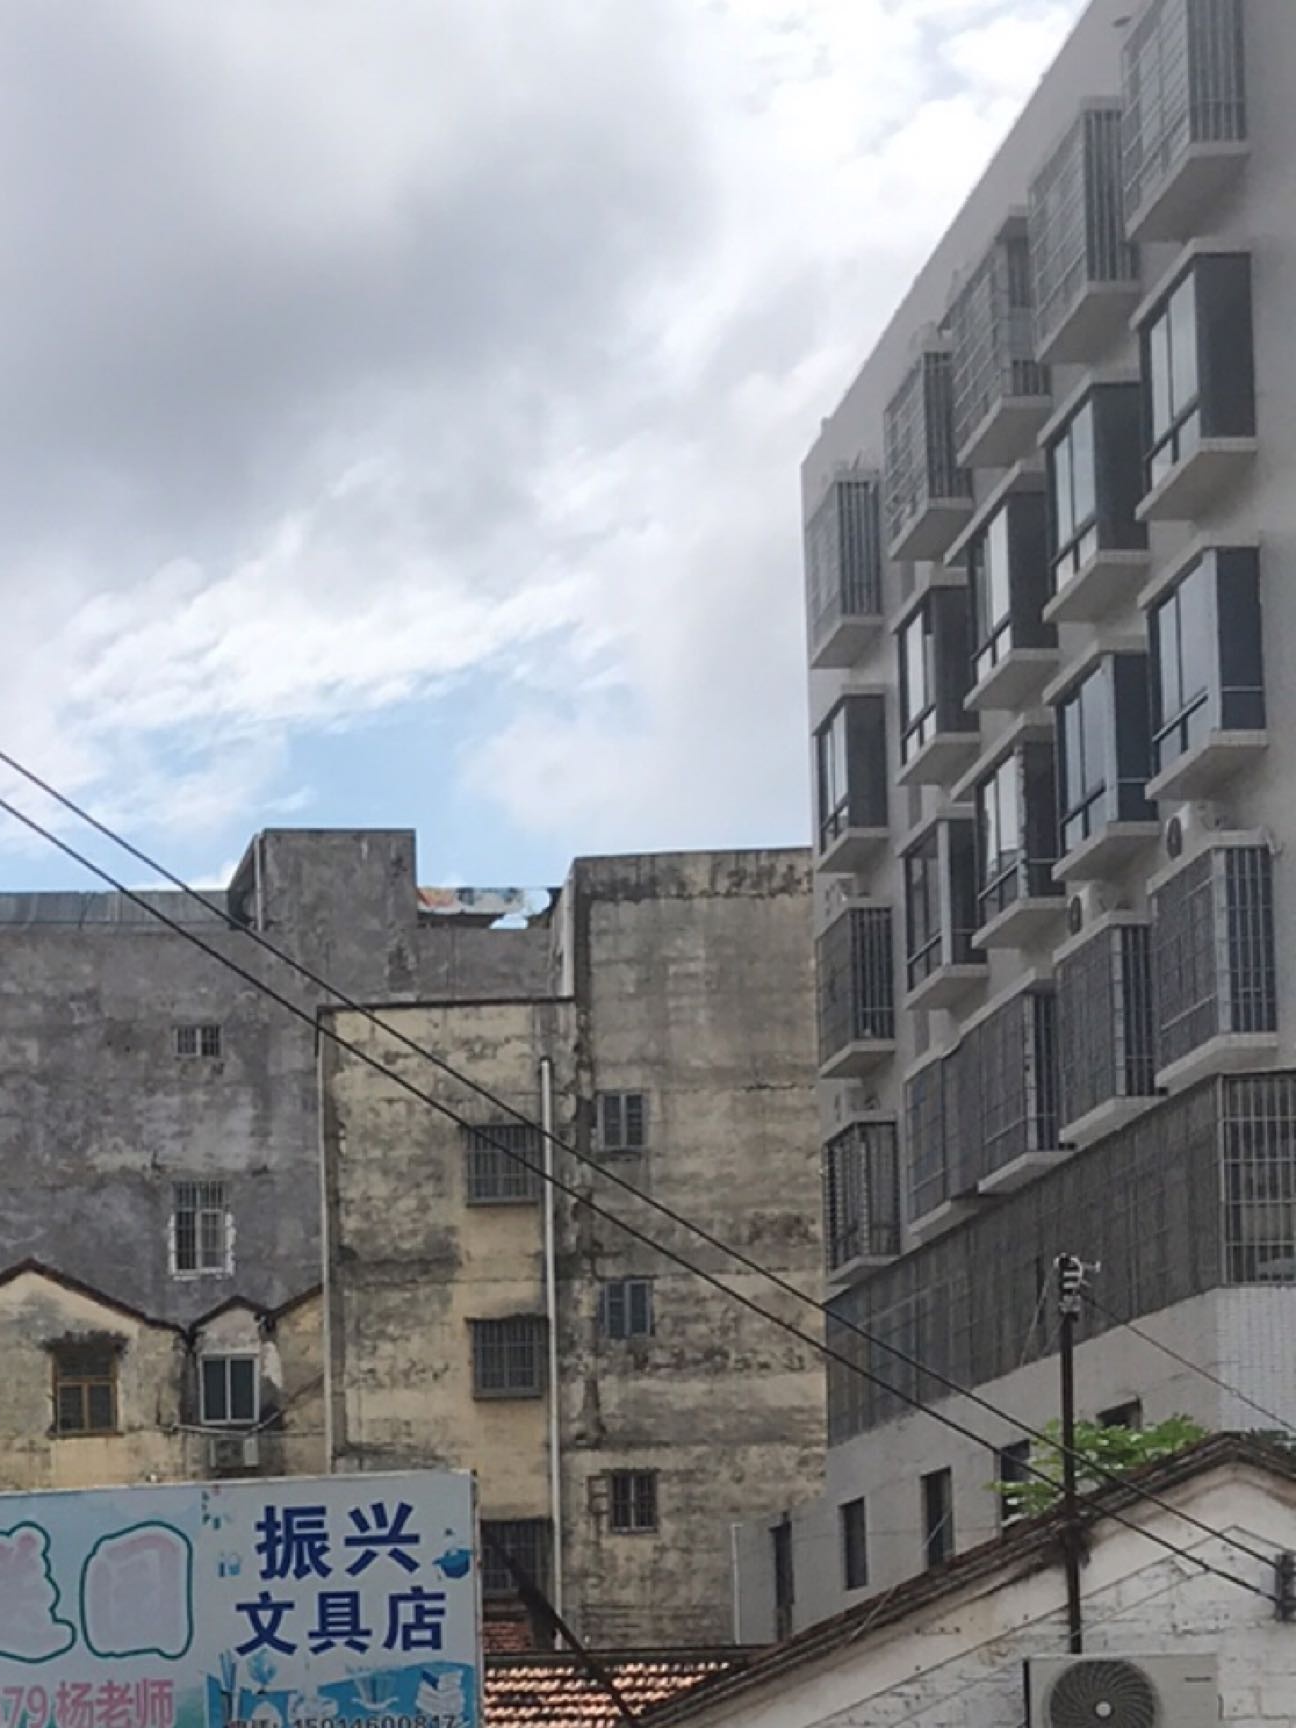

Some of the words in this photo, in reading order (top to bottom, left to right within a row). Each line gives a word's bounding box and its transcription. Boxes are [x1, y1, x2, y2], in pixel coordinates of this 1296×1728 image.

[255, 1502, 421, 1580] 振兴
[236, 1586, 446, 1656] 文具店
